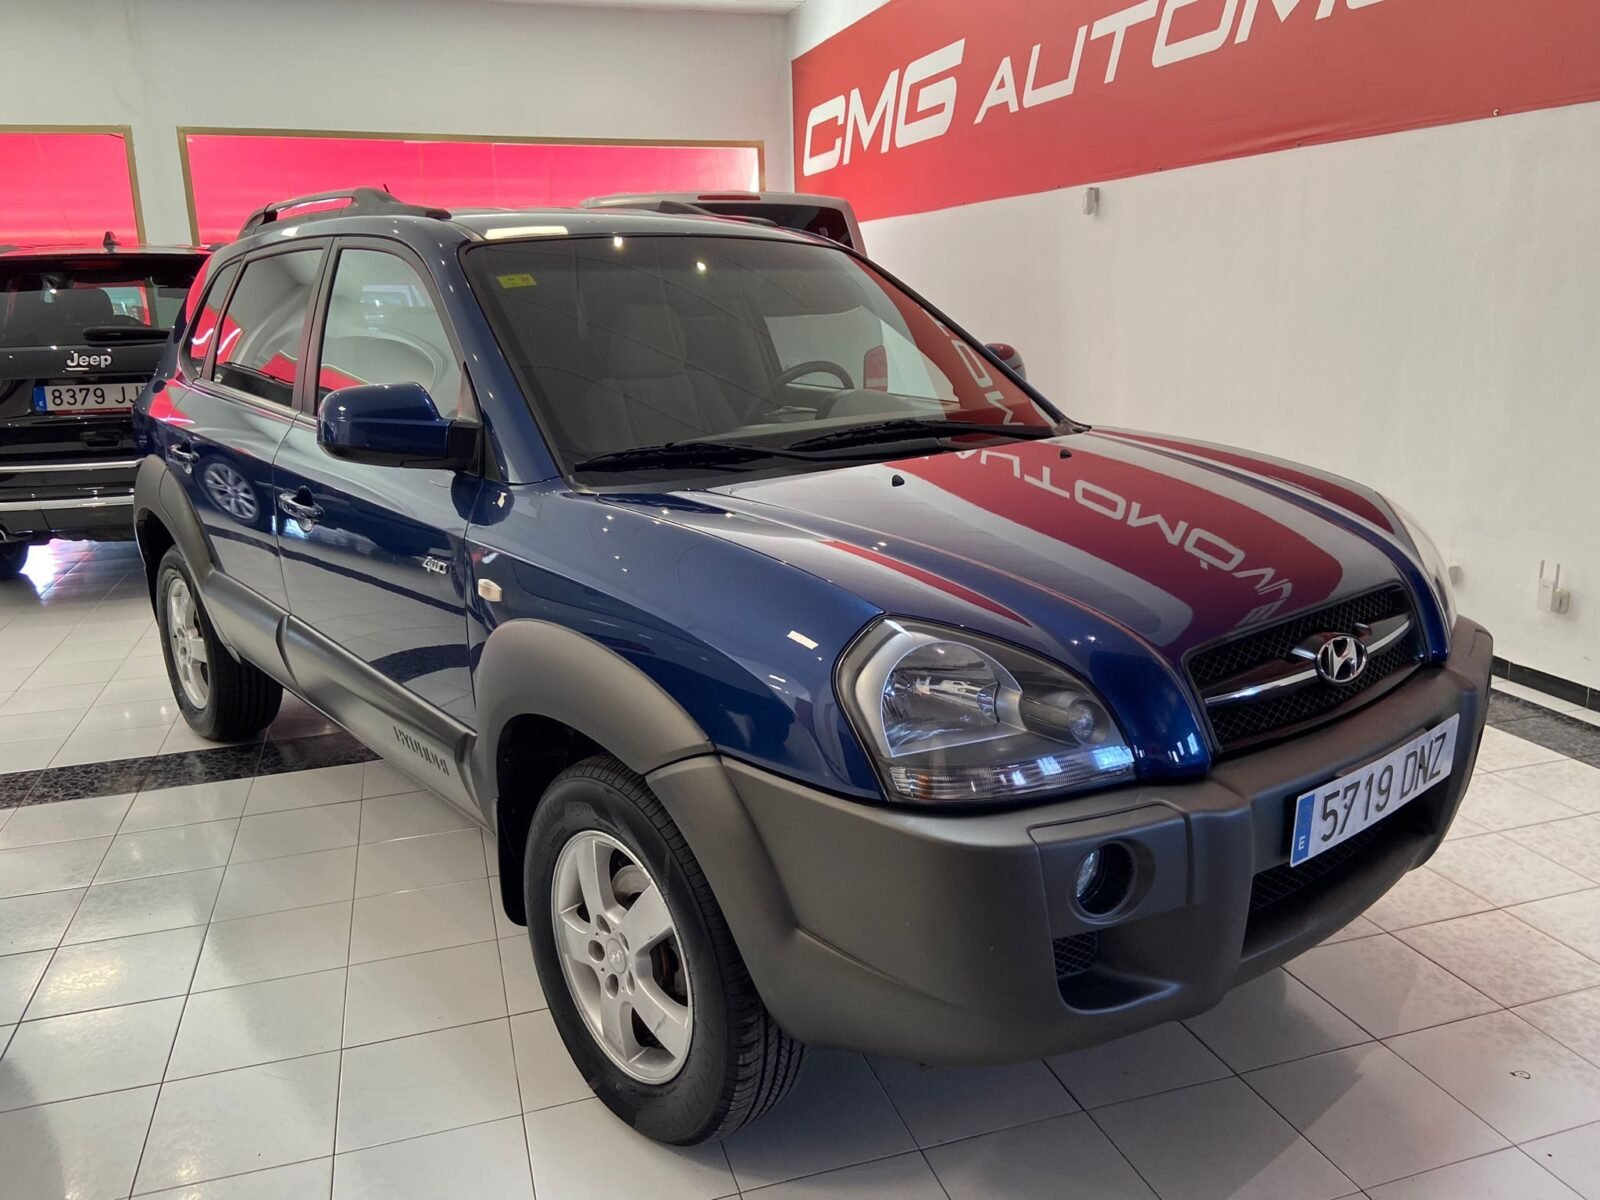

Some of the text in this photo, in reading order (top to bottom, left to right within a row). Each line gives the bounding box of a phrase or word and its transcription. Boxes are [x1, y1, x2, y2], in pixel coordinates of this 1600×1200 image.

[803, 0, 1387, 178] CMG AUTO
[66, 352, 112, 368] Jeep
[52, 387, 105, 406] 8379
[115, 386, 144, 404] JJ
[1298, 731, 1447, 851] E 5719 DNZ
